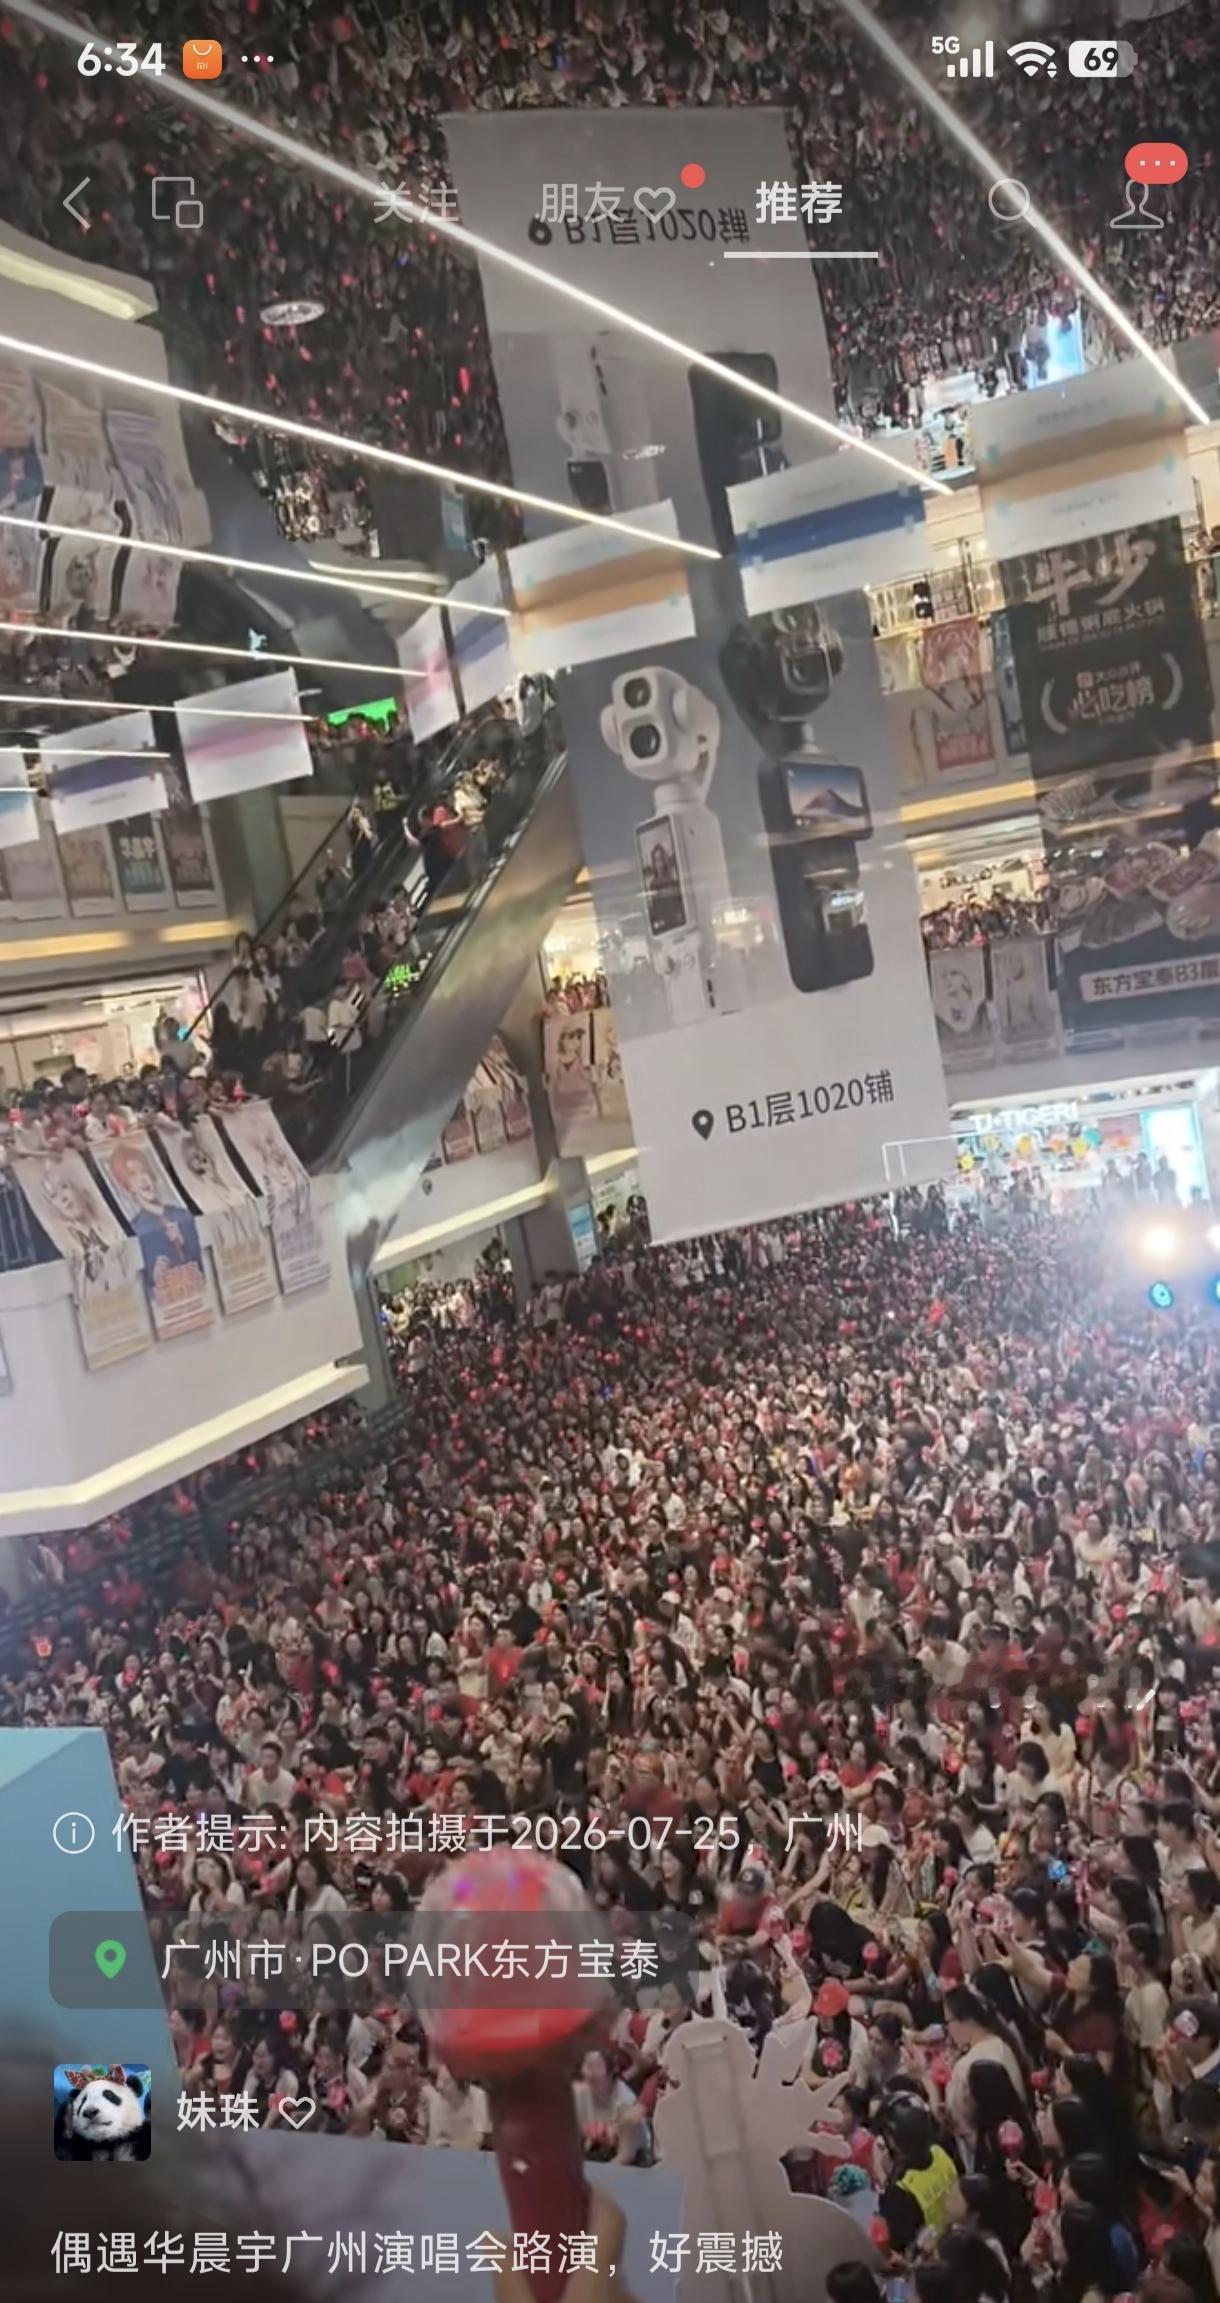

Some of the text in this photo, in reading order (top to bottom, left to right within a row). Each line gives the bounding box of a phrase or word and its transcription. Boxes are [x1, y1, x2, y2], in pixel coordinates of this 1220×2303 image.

[1072, 676, 1155, 720] 必吃榜
[725, 1069, 895, 1134] B1层1020铺
